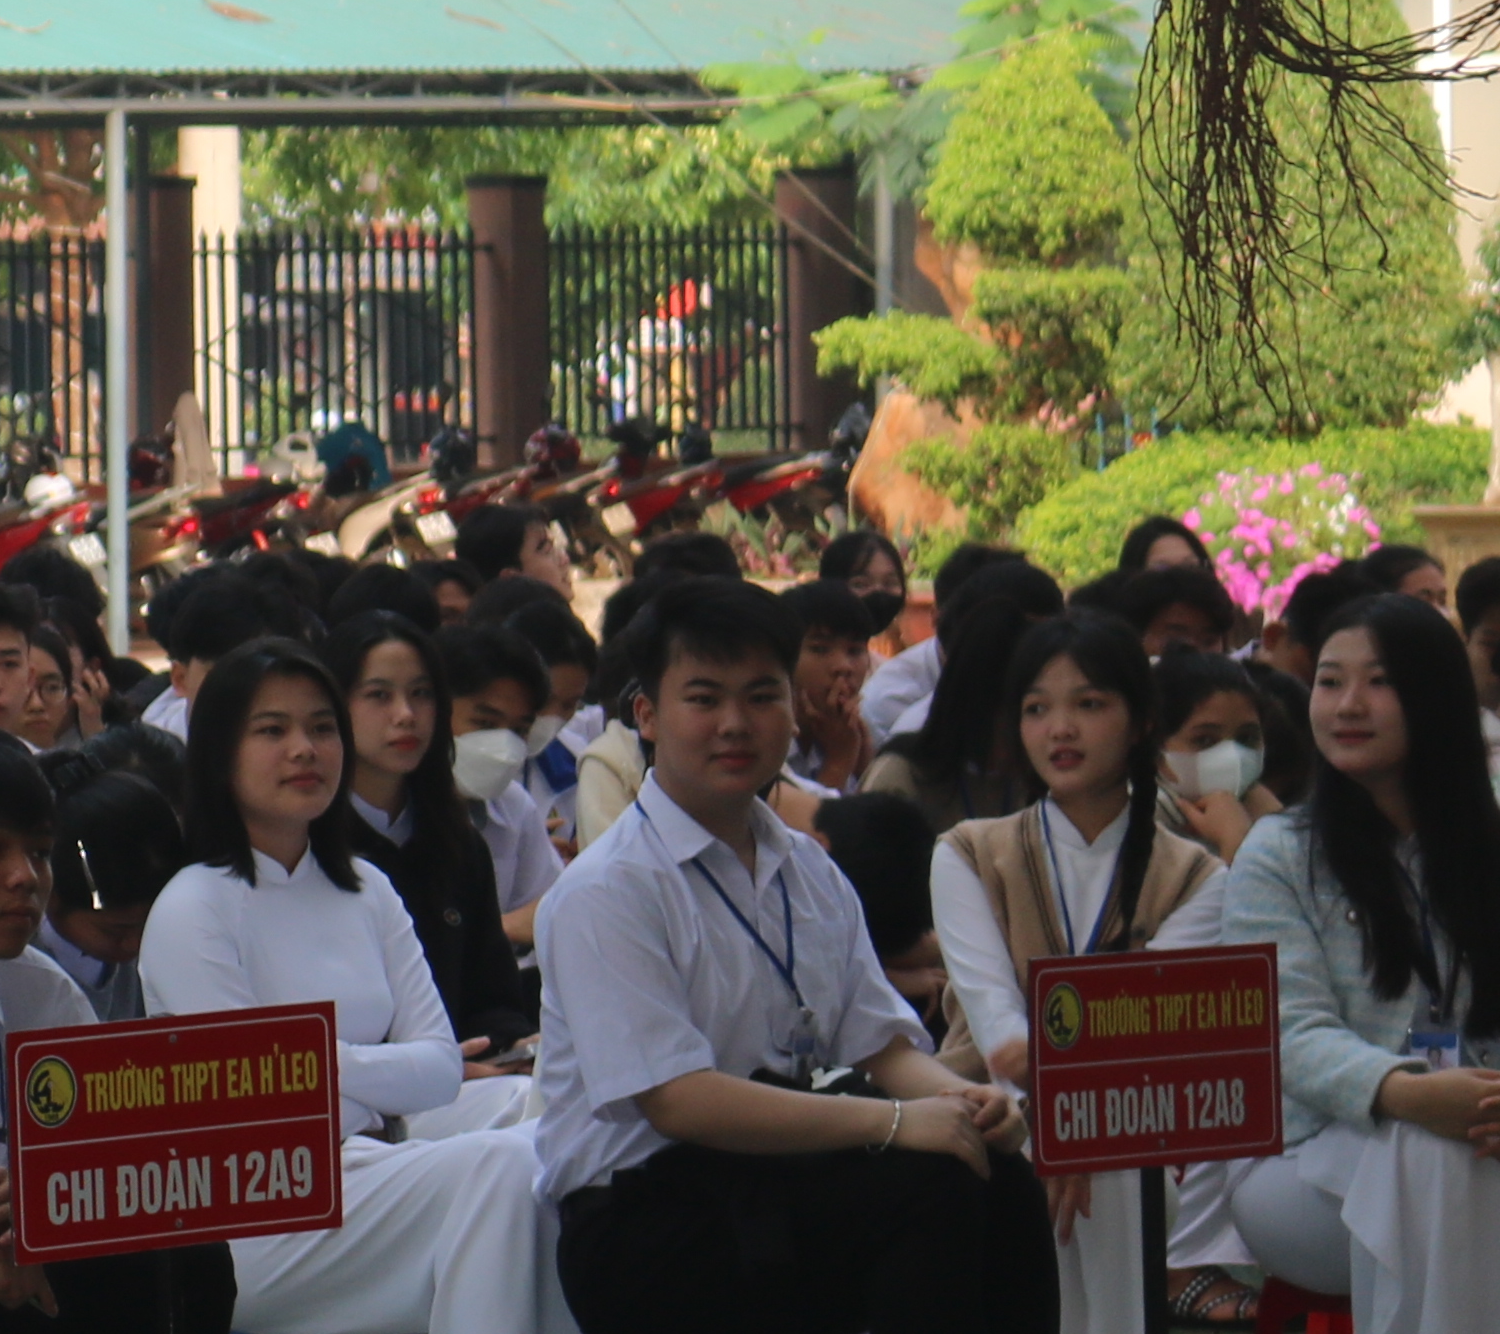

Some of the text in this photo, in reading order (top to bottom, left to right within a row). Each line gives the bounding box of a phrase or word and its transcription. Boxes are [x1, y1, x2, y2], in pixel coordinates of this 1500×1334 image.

[1088, 989, 1149, 1037] TRƯỜNG
[1156, 994, 1192, 1032] THPT
[1199, 992, 1217, 1028] EA
[83, 1063, 165, 1113] TRƯỜNG
[170, 1058, 220, 1104] THPT
[227, 1056, 253, 1098] EA
[1054, 1073, 1246, 1142] CHI ĐOÀN 12A8
[47, 1147, 313, 1225] CHI ĐOÀN 12A9
